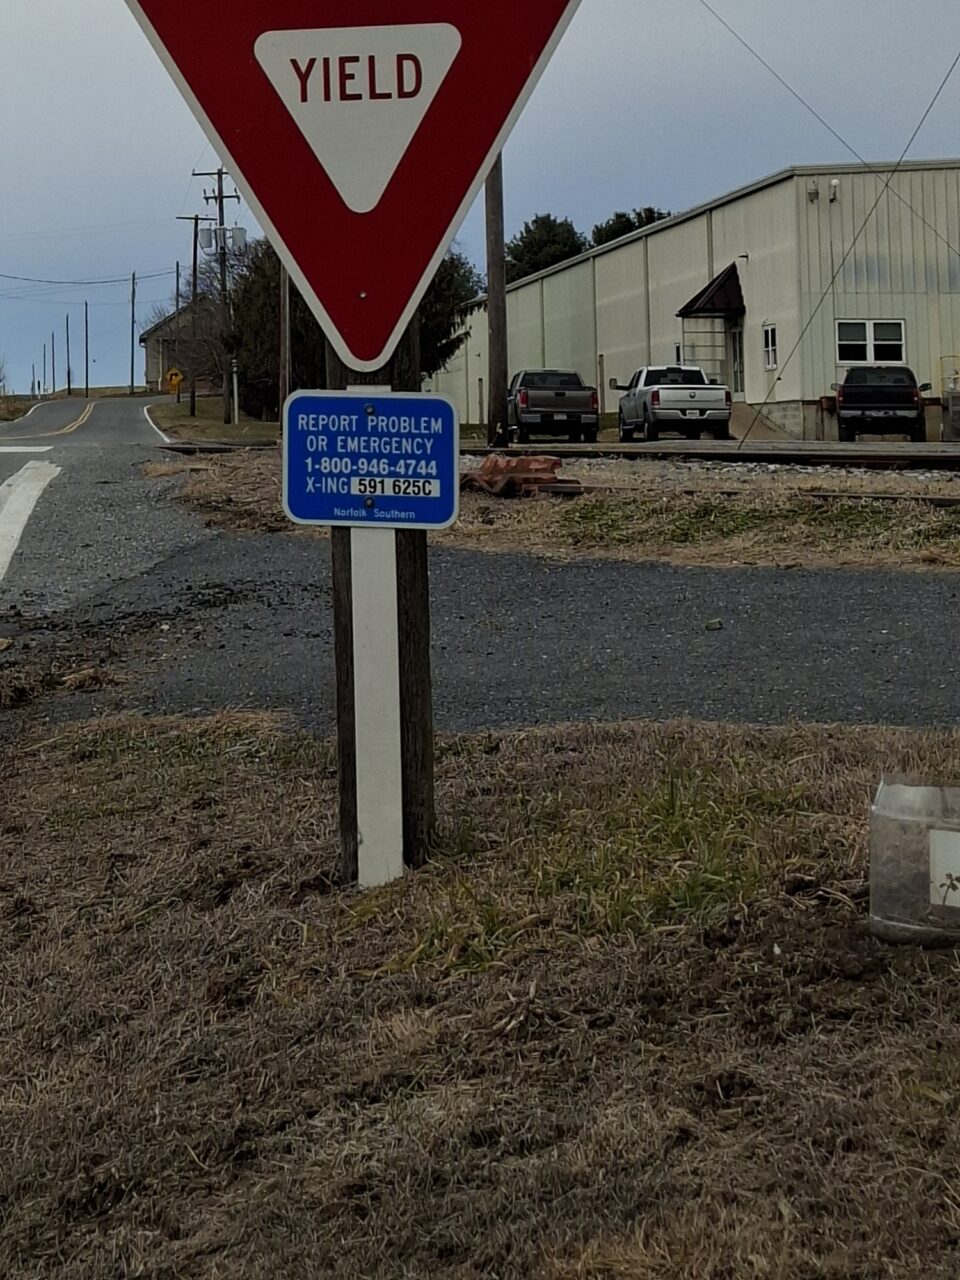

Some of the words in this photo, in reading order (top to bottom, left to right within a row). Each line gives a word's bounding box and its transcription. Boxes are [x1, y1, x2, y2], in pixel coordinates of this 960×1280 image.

[289, 53, 423, 103] YIELD
[298, 414, 359, 432] REPORT
[367, 416, 443, 434] PROBLEM
[306, 435, 328, 452] OR
[337, 436, 434, 455] EMERGENCY
[305, 457, 438, 476] 1-800-946-4744
[306, 476, 349, 494] X-ING
[358, 478, 385, 495] 591
[392, 479, 433, 496] 625C
[333, 507, 368, 518] Norfolk
[373, 508, 417, 520] Southern
